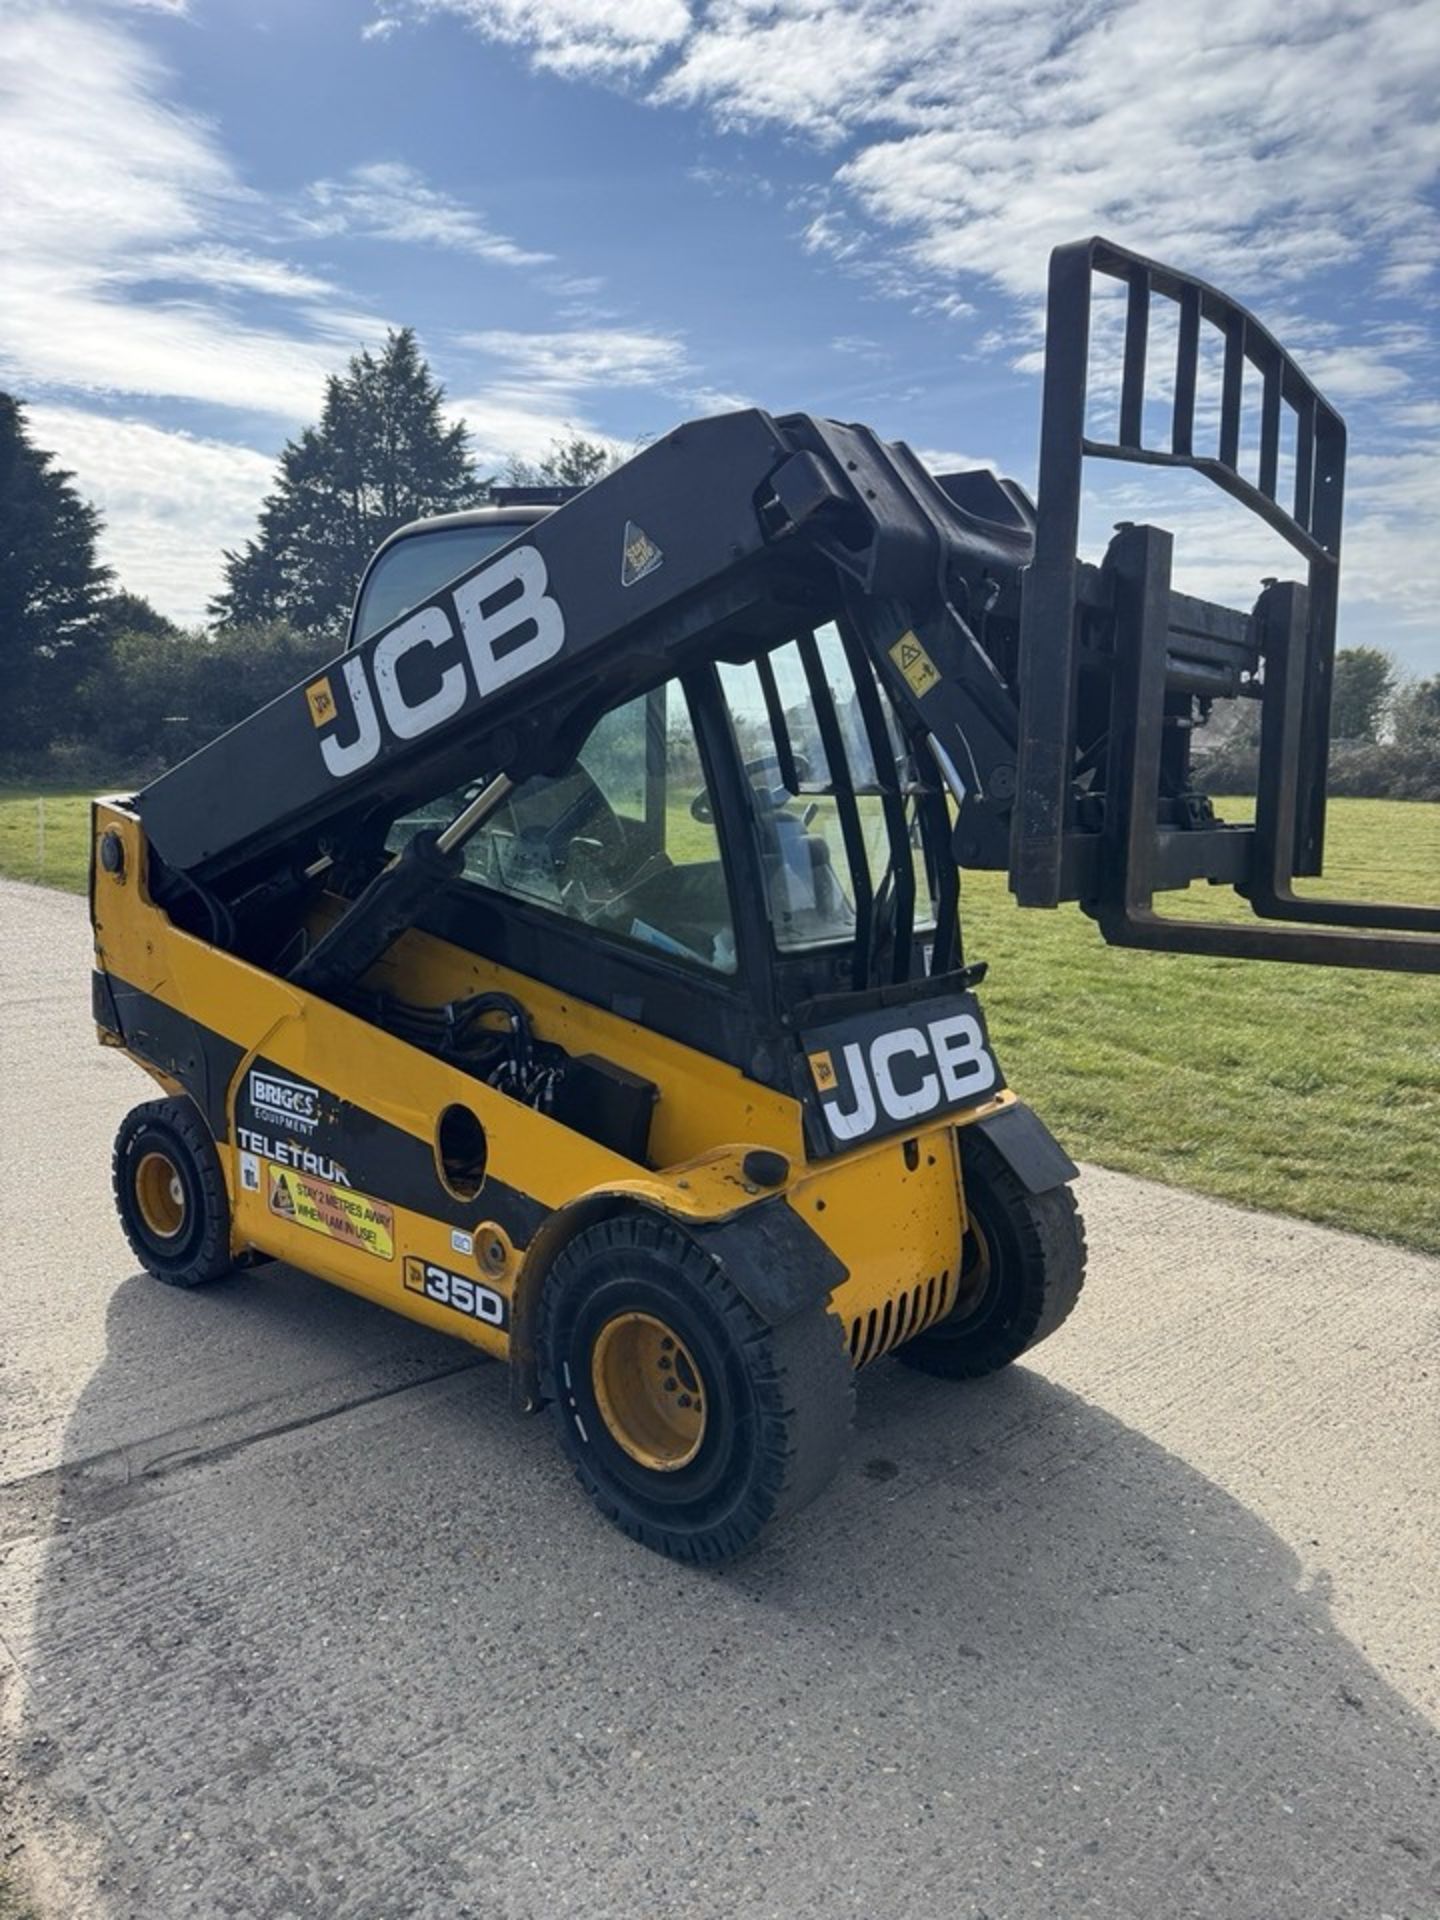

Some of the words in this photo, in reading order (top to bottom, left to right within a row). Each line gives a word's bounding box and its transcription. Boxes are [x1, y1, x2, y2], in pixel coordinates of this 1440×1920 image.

[320, 545, 565, 777] JCB
[255, 1080, 314, 1115] BRIGGS
[823, 1014, 995, 1141] JCB
[254, 1108, 314, 1136] EQUIPMENT
[296, 1183, 318, 1200] STAY
[325, 1194, 363, 1217] METRES
[364, 1208, 391, 1227] AWAY
[296, 1204, 326, 1222] WHEN
[426, 1266, 503, 1325] 35D
